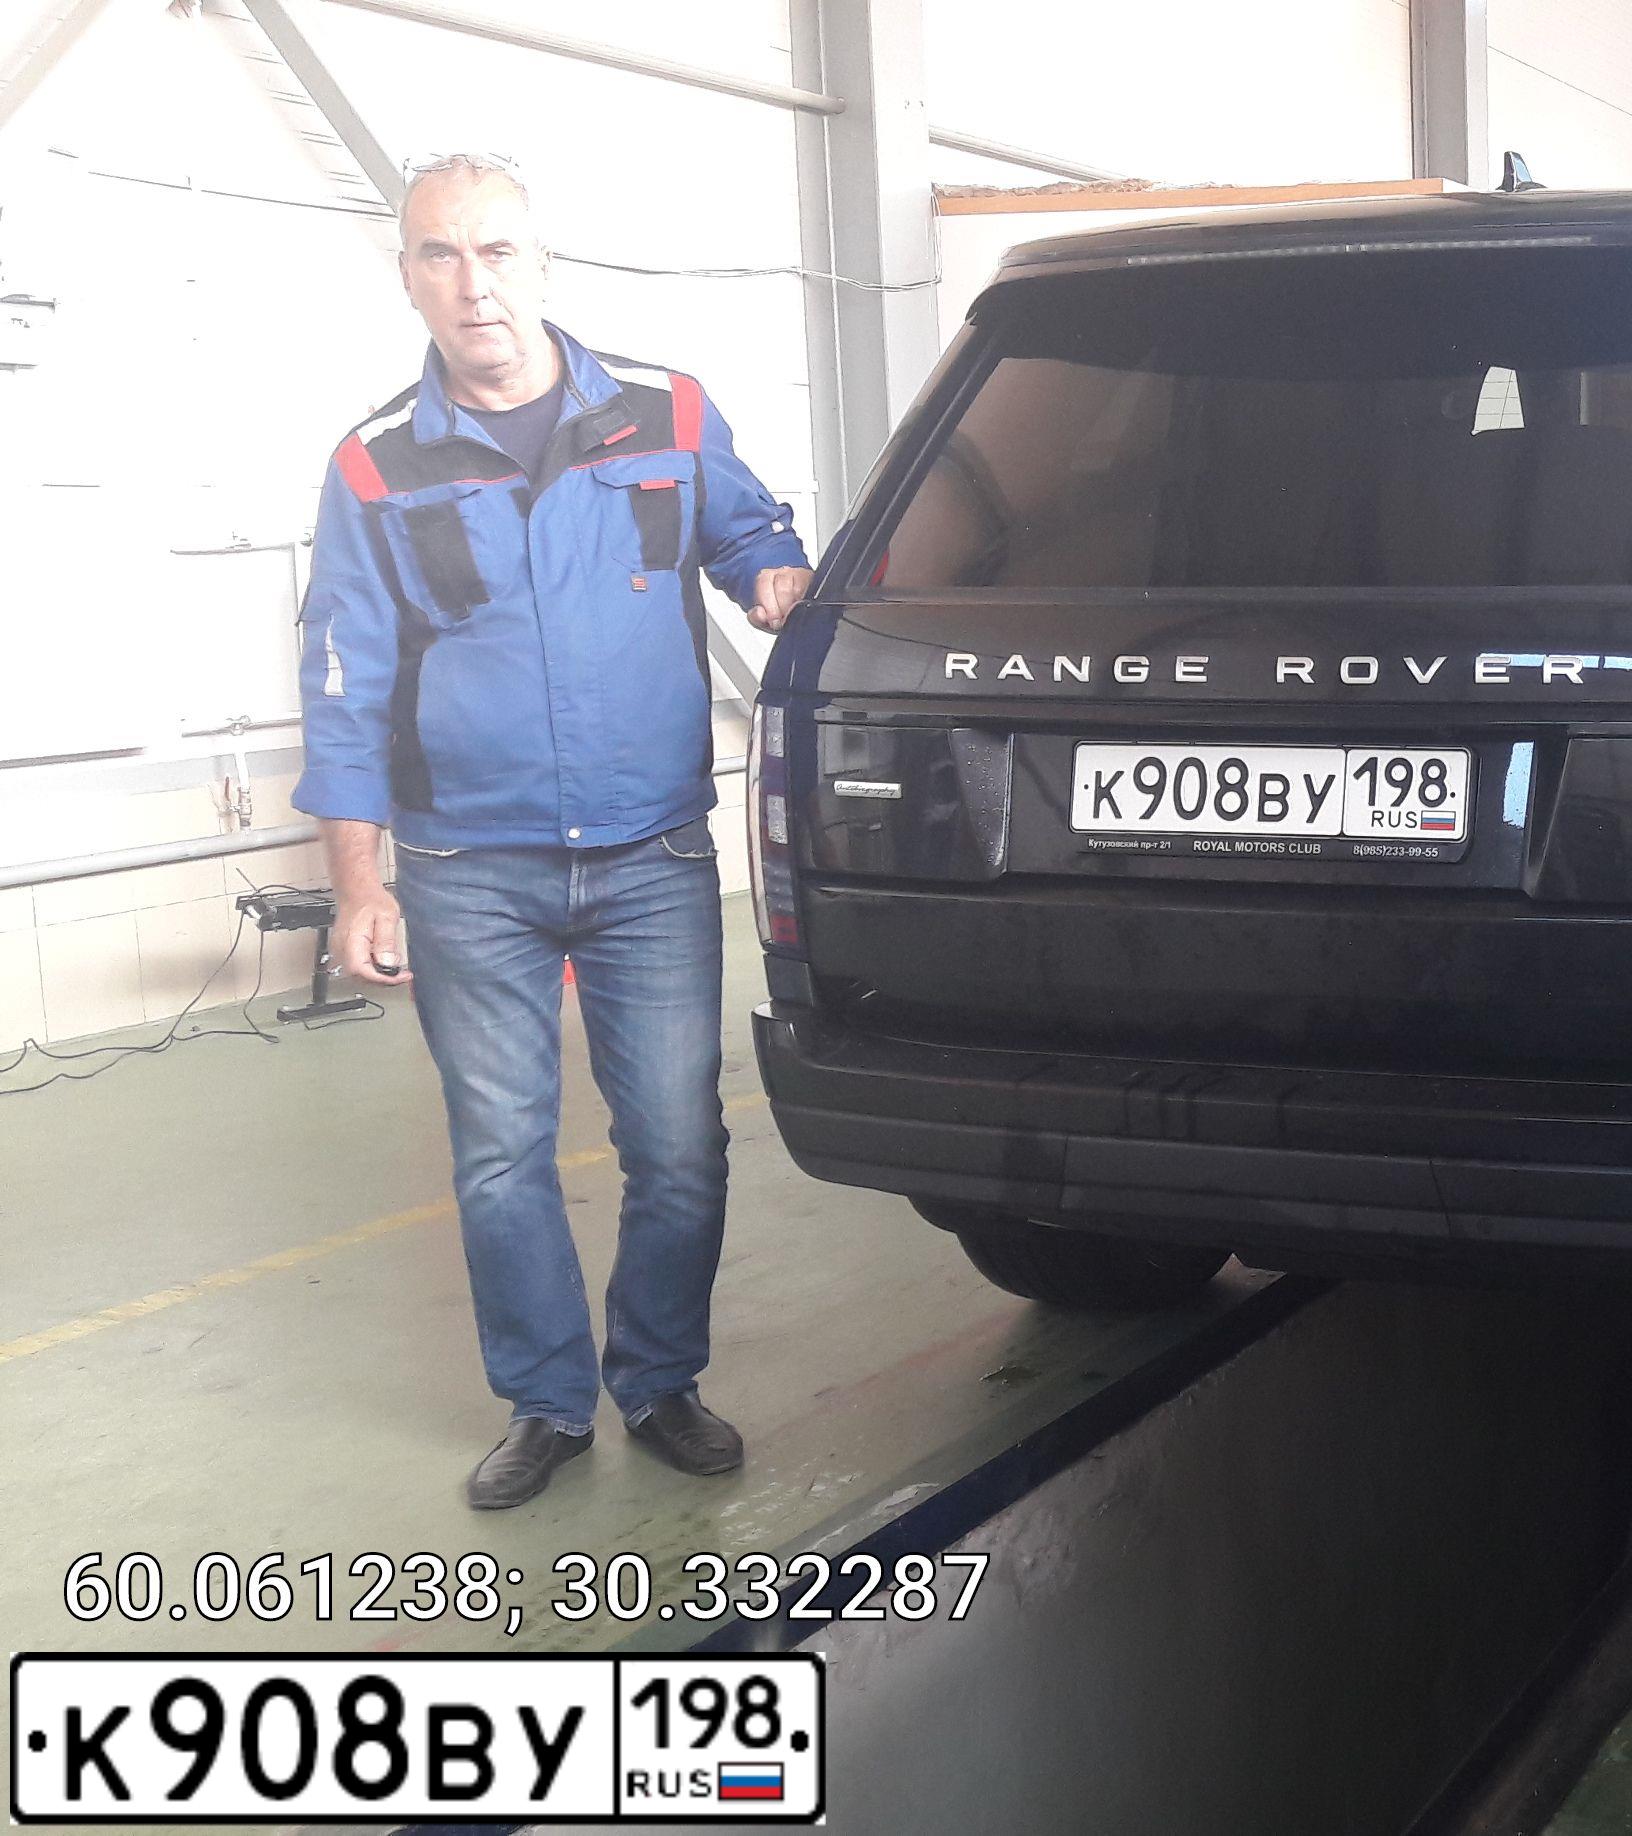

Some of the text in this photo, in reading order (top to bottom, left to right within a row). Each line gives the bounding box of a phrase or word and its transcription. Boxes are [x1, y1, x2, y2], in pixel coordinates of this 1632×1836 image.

[944, 652, 1584, 685] RANGE ROVER
[1353, 756, 1448, 808] 198
[1371, 810, 1418, 829] RUS
[1088, 838, 1171, 850] Кутузовский пр-т 2/1
[1193, 840, 1322, 855] ROYAL MOTORS CLUB
